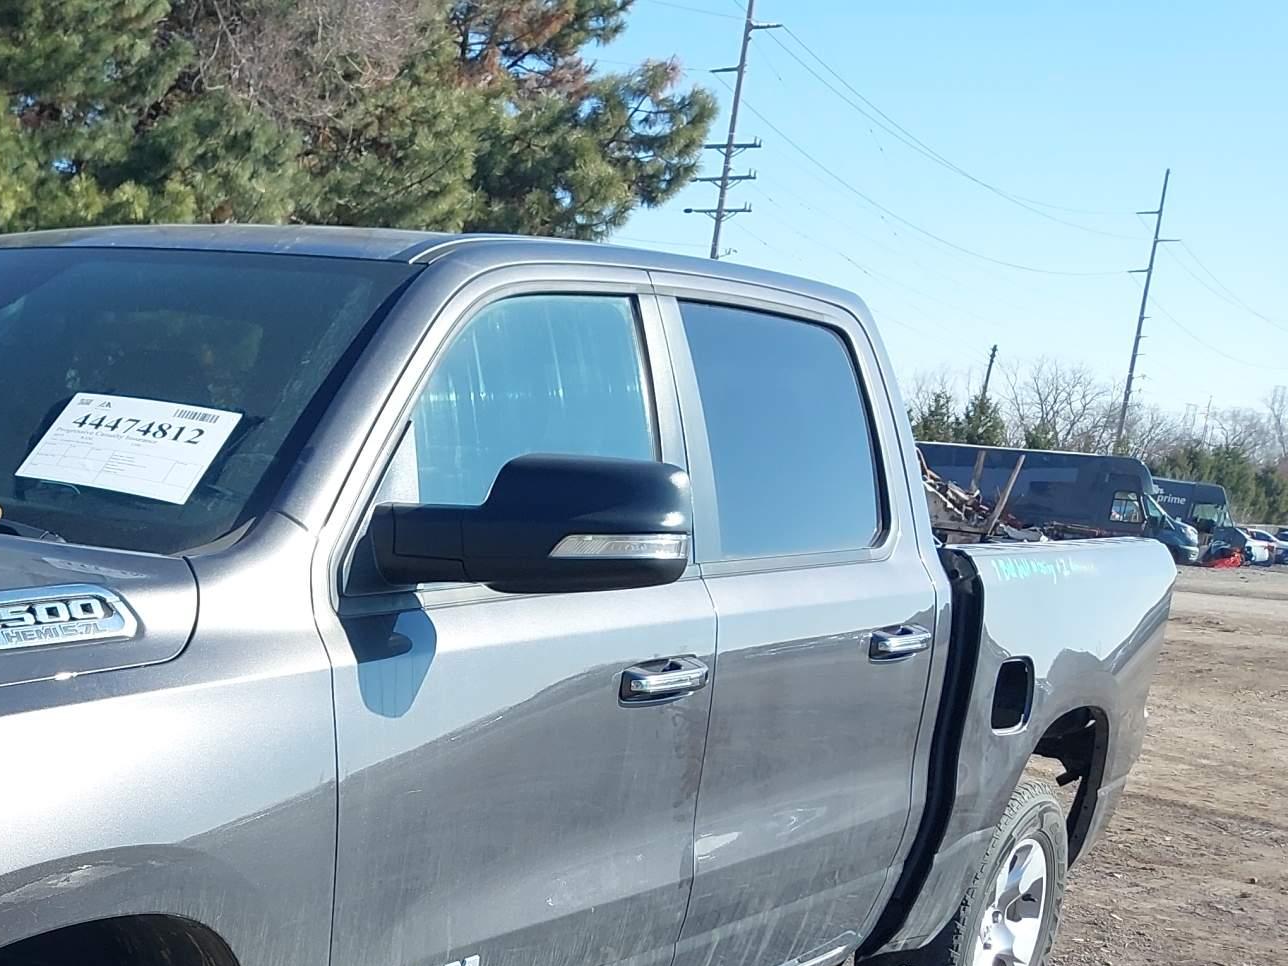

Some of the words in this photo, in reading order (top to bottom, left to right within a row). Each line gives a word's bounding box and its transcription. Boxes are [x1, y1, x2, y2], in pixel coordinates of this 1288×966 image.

[72, 413, 205, 445] 44474812
[1157, 493, 1186, 504] prime
[2, 627, 60, 643] HEMI
[62, 623, 107, 637] 5.7L
